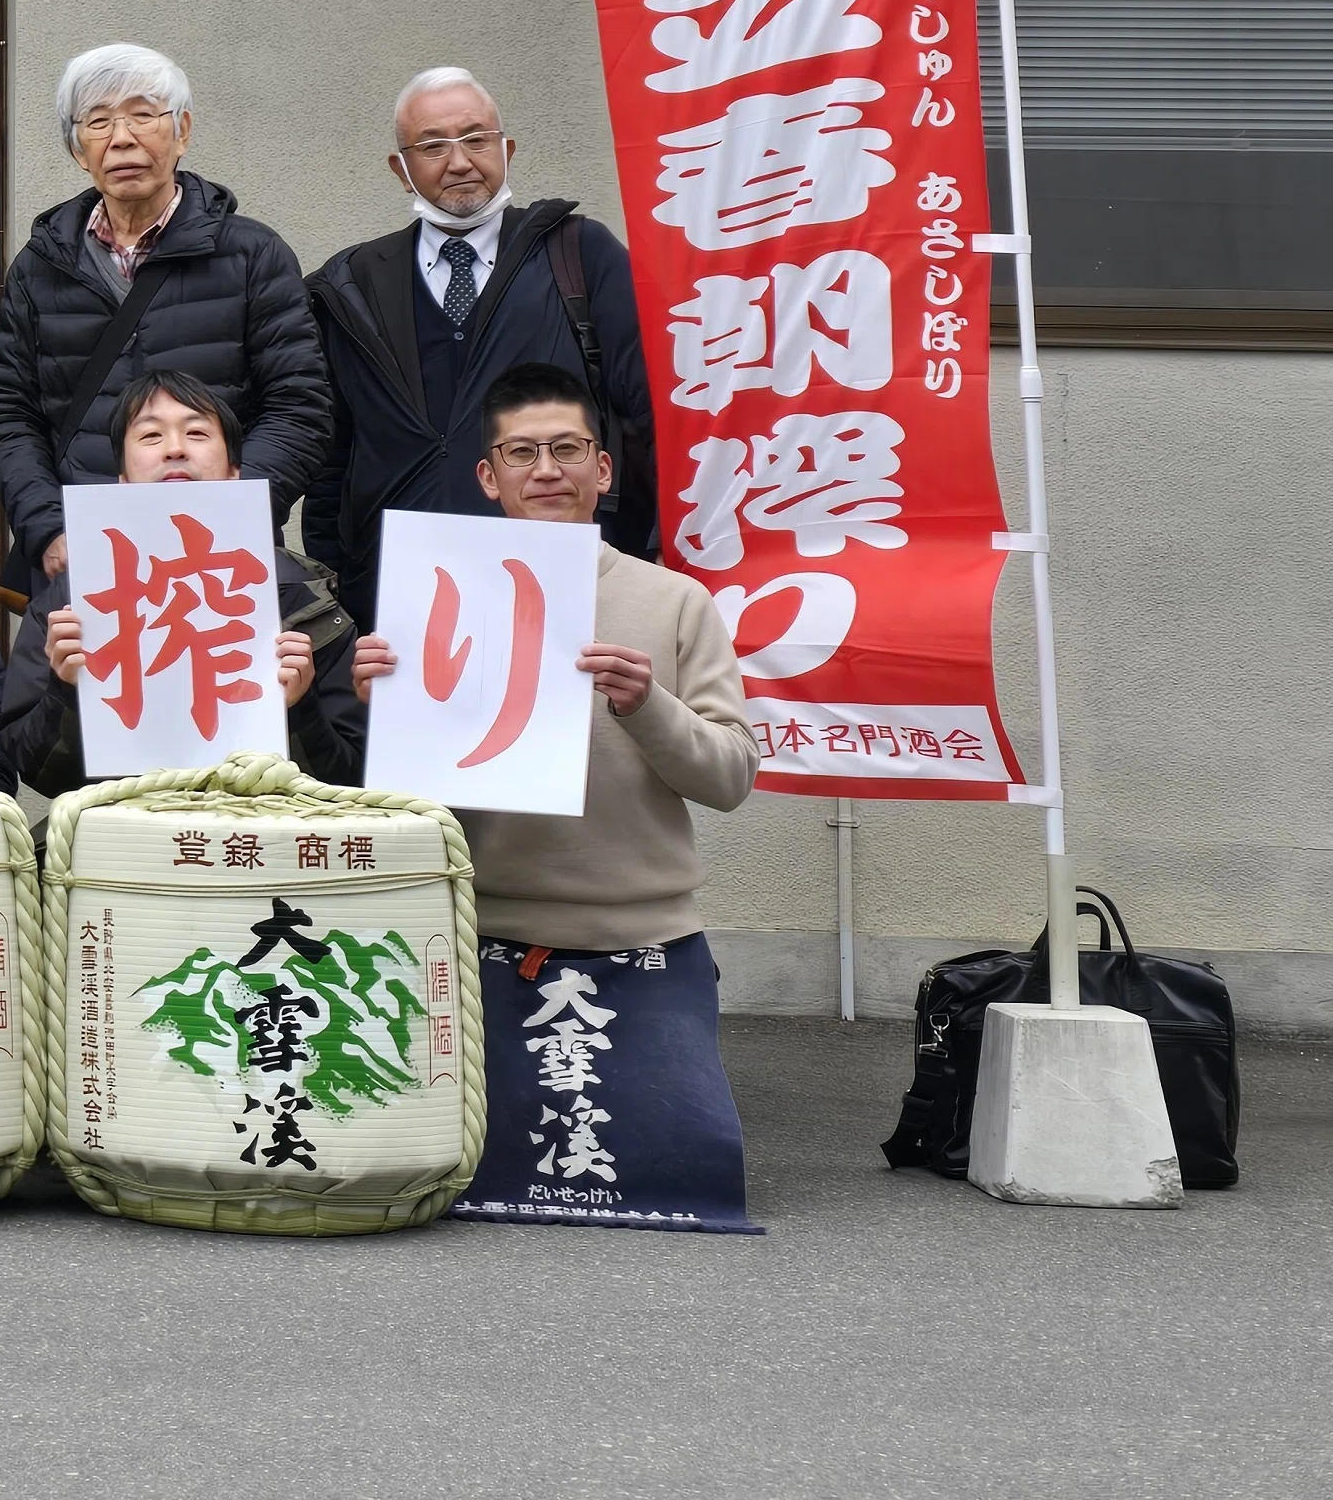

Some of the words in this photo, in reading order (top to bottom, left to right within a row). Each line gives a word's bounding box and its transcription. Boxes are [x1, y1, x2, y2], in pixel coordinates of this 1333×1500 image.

[917, 172, 969, 399] あさしぼり
[83, 514, 268, 742] 搾
[423, 558, 545, 769] り
[752, 717, 986, 762] 日本名門酒会
[233, 897, 332, 1171] 大雪渓
[521, 967, 618, 1183] 大雪渓
[528, 1184, 623, 1204] だいせっけい
